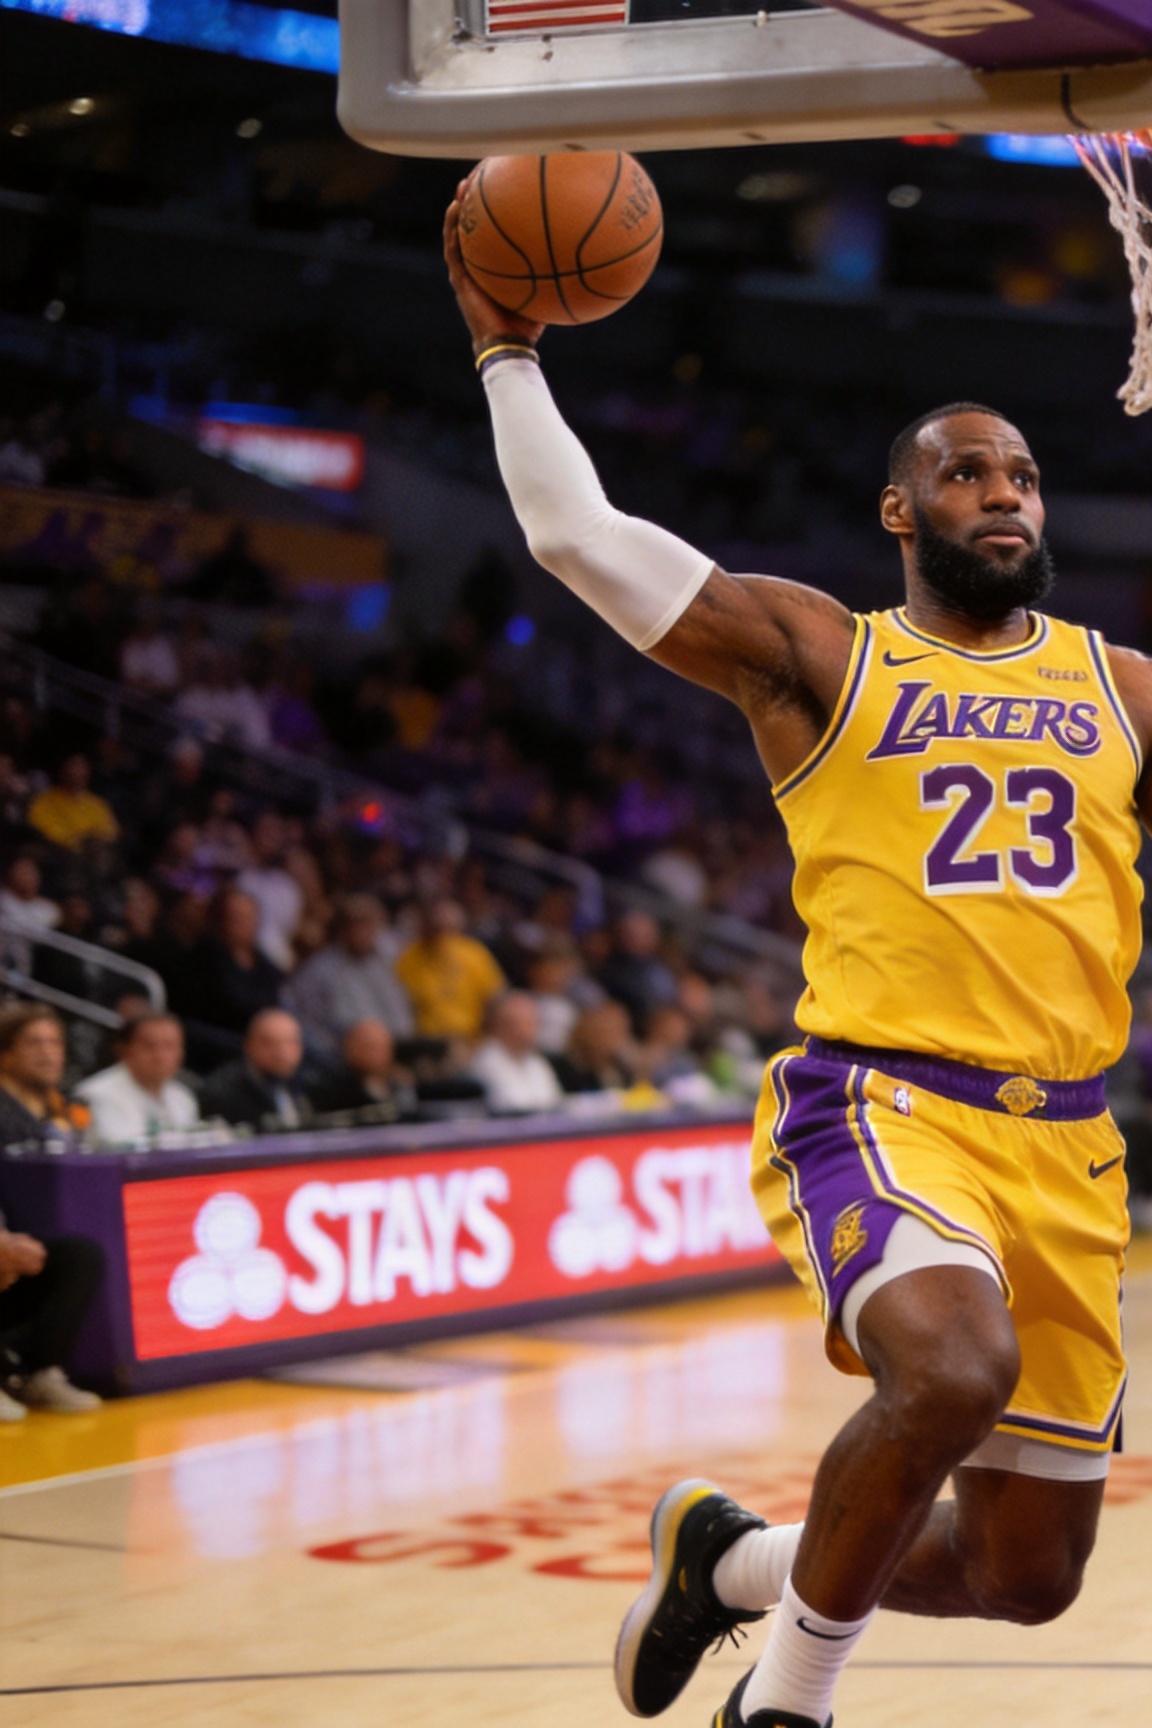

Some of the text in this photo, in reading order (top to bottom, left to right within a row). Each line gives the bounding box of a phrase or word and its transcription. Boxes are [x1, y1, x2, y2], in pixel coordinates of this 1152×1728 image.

[866, 681, 1102, 761] LAKERS
[919, 763, 1079, 897] 23
[285, 1167, 514, 1315] STAYS
